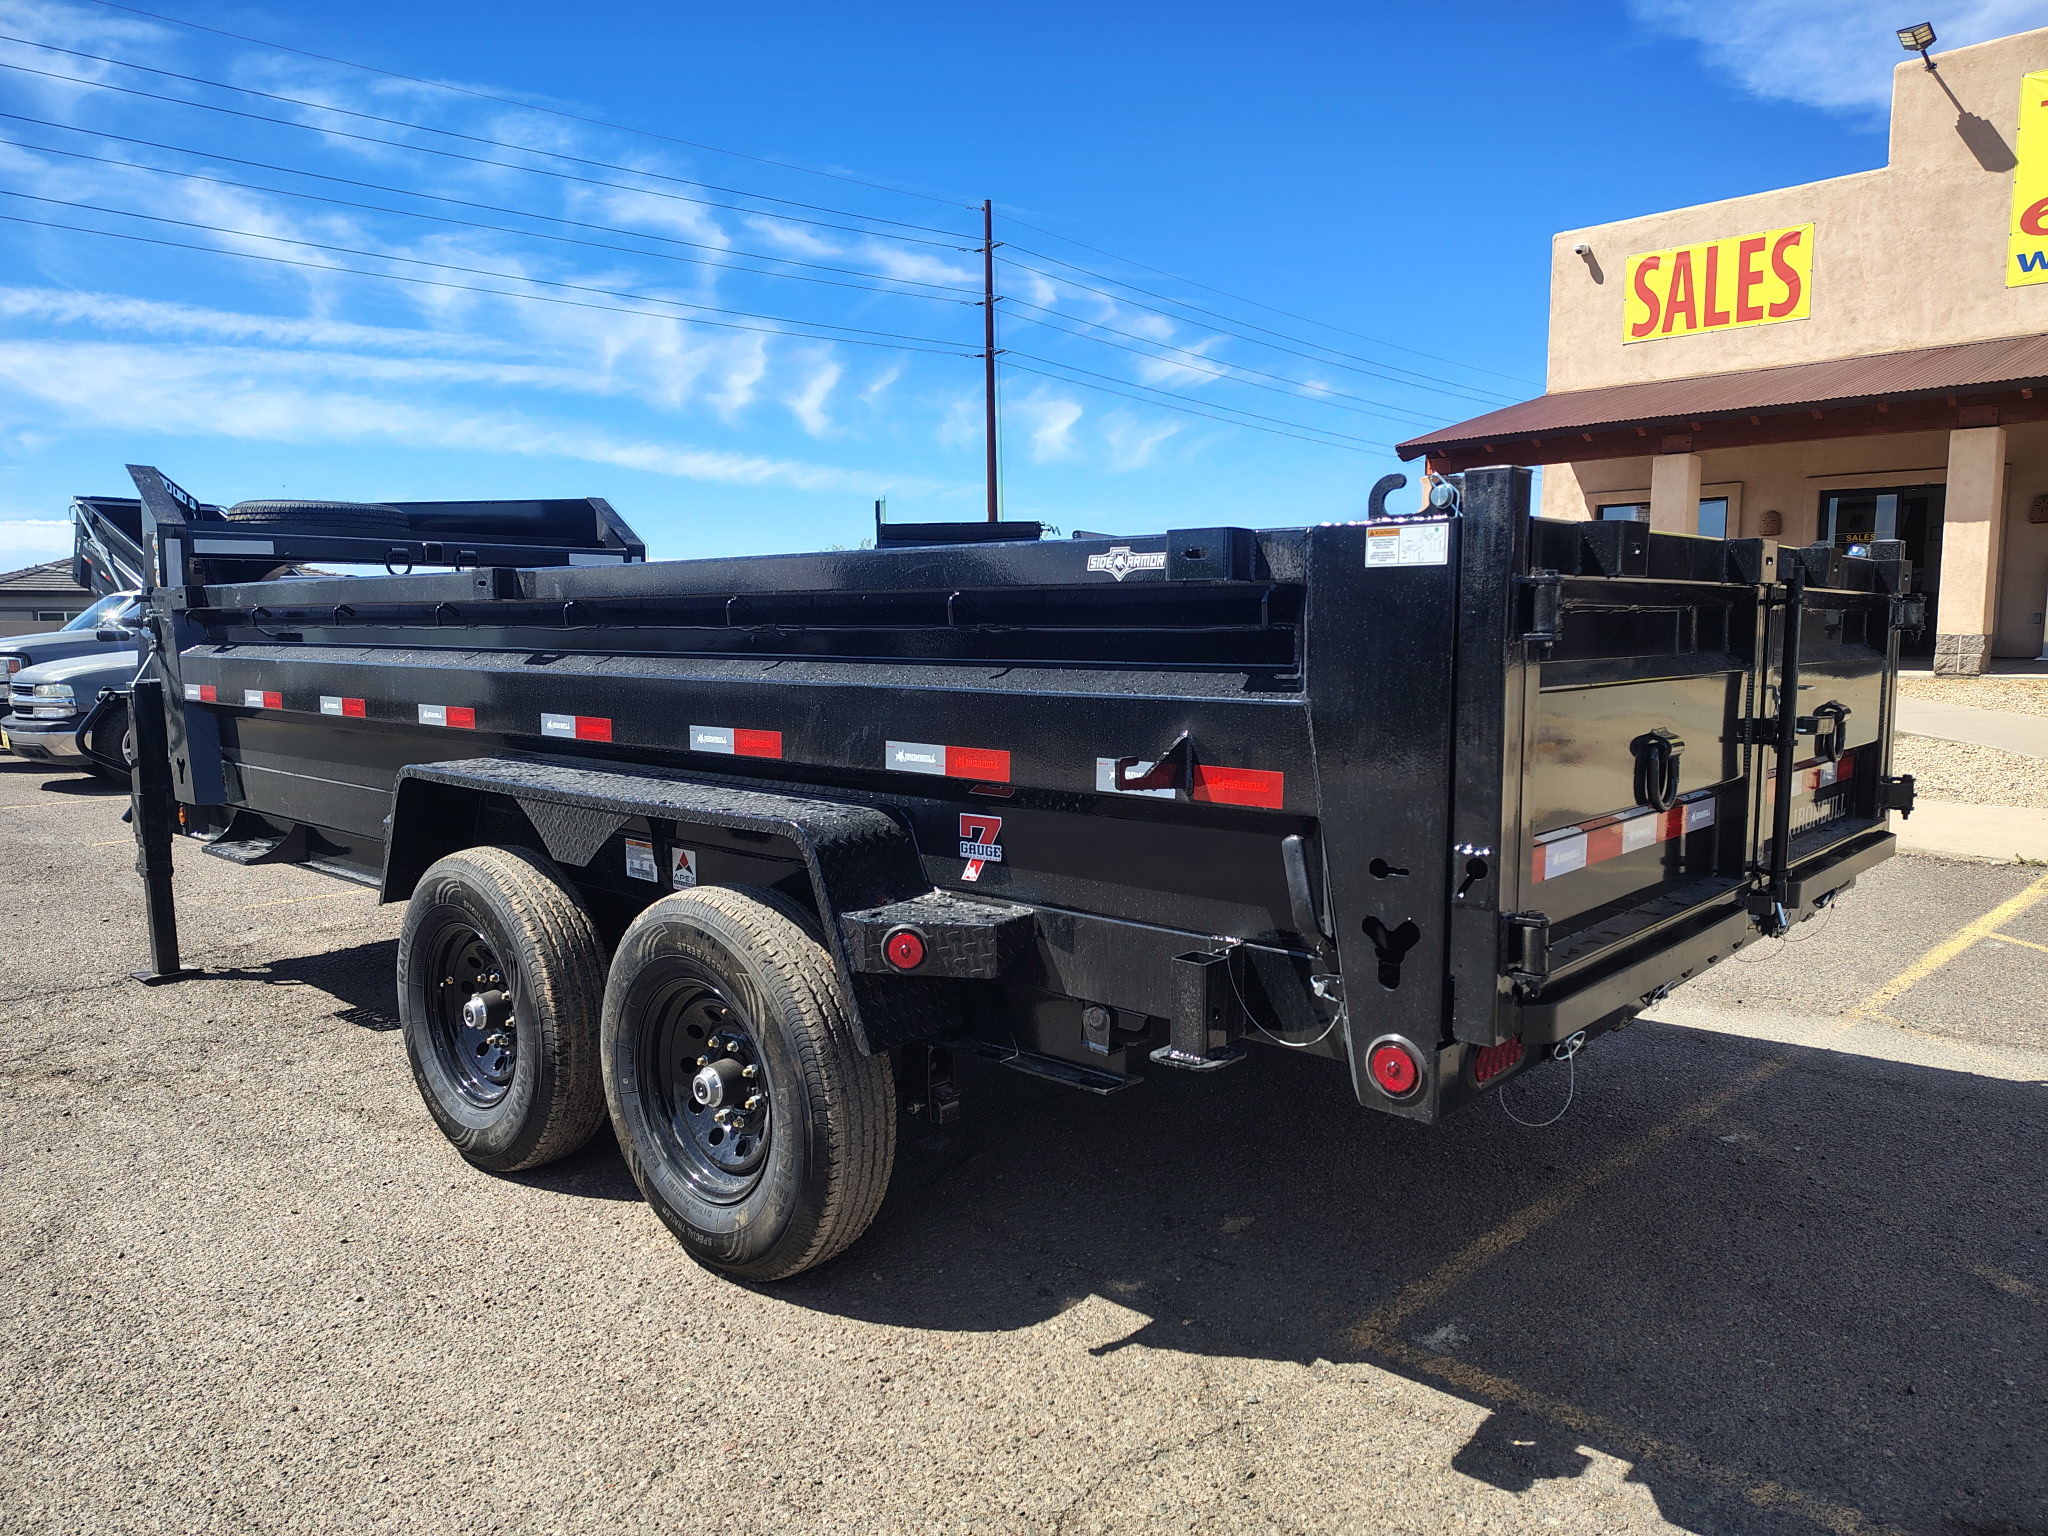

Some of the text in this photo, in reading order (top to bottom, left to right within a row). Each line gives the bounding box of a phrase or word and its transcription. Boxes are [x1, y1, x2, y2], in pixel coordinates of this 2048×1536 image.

[1631, 231, 1802, 337] SALES
[1846, 533, 1876, 542] SALES
[1090, 554, 1165, 568] SIDE ARMOR
[960, 842, 1001, 858] GAUGE
[674, 873, 695, 883] APEX
[661, 1204, 713, 1247] SPECIAL TRAILER
